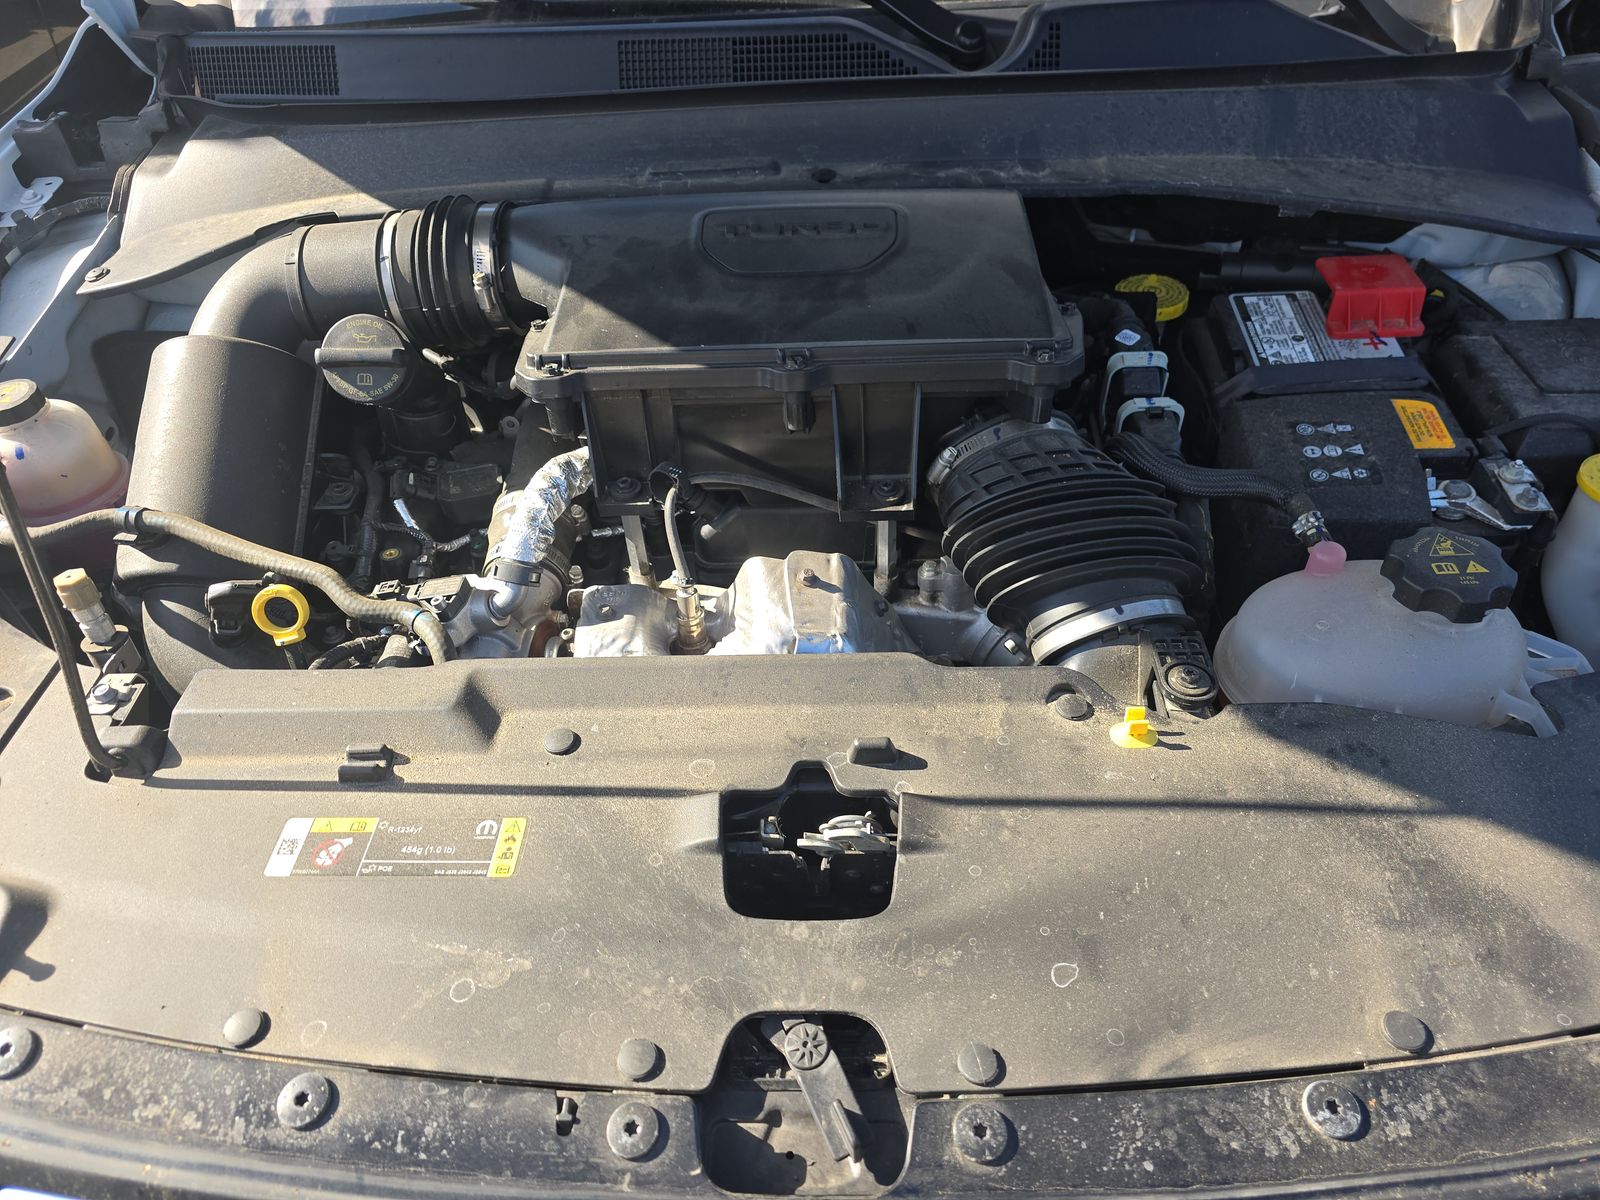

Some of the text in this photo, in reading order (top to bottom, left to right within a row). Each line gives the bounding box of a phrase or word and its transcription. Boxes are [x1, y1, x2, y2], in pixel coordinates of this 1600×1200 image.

[346, 320, 384, 330] ENGINE OIL
[401, 844, 456, 856] 454g (1.0 lb)
